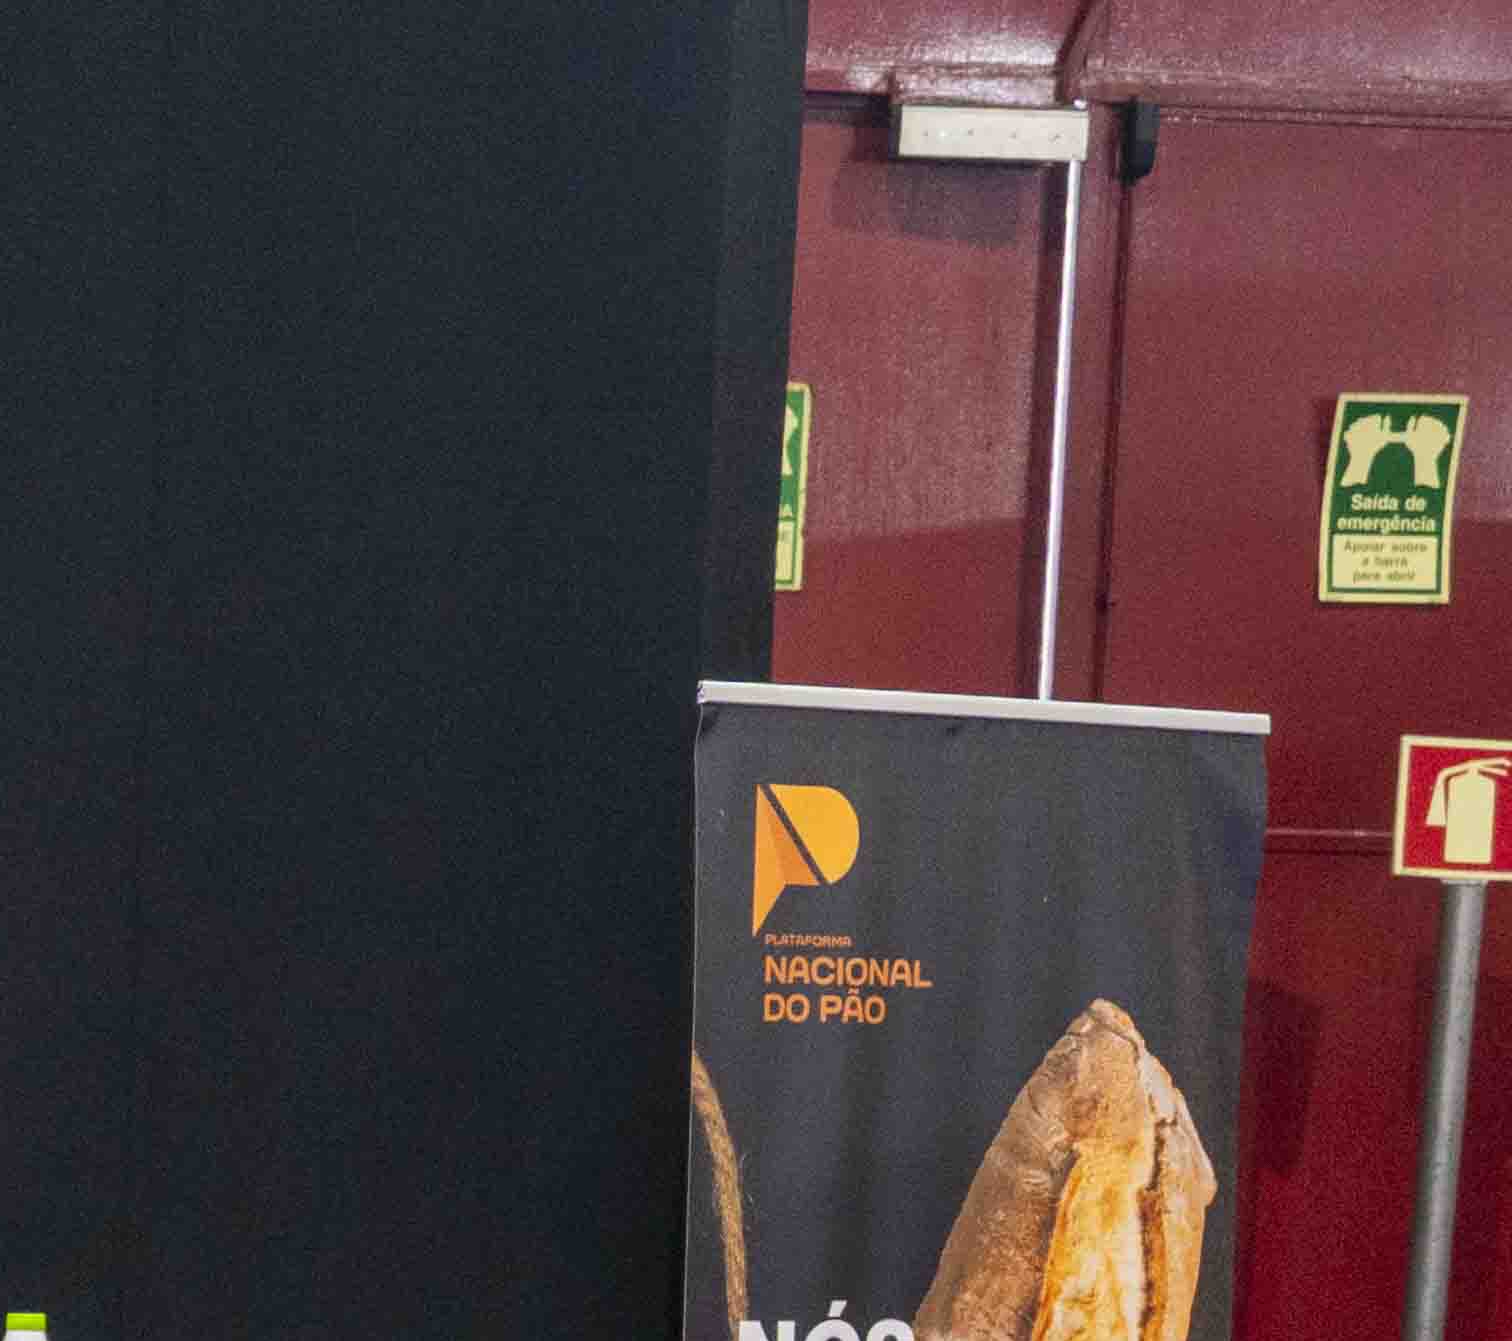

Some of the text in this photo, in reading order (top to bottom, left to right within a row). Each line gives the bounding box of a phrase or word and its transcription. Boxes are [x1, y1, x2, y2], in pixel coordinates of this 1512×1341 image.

[1405, 494, 1427, 511] de
[763, 955, 933, 989] NACIONAL
[762, 985, 887, 1025] DO PÃO
